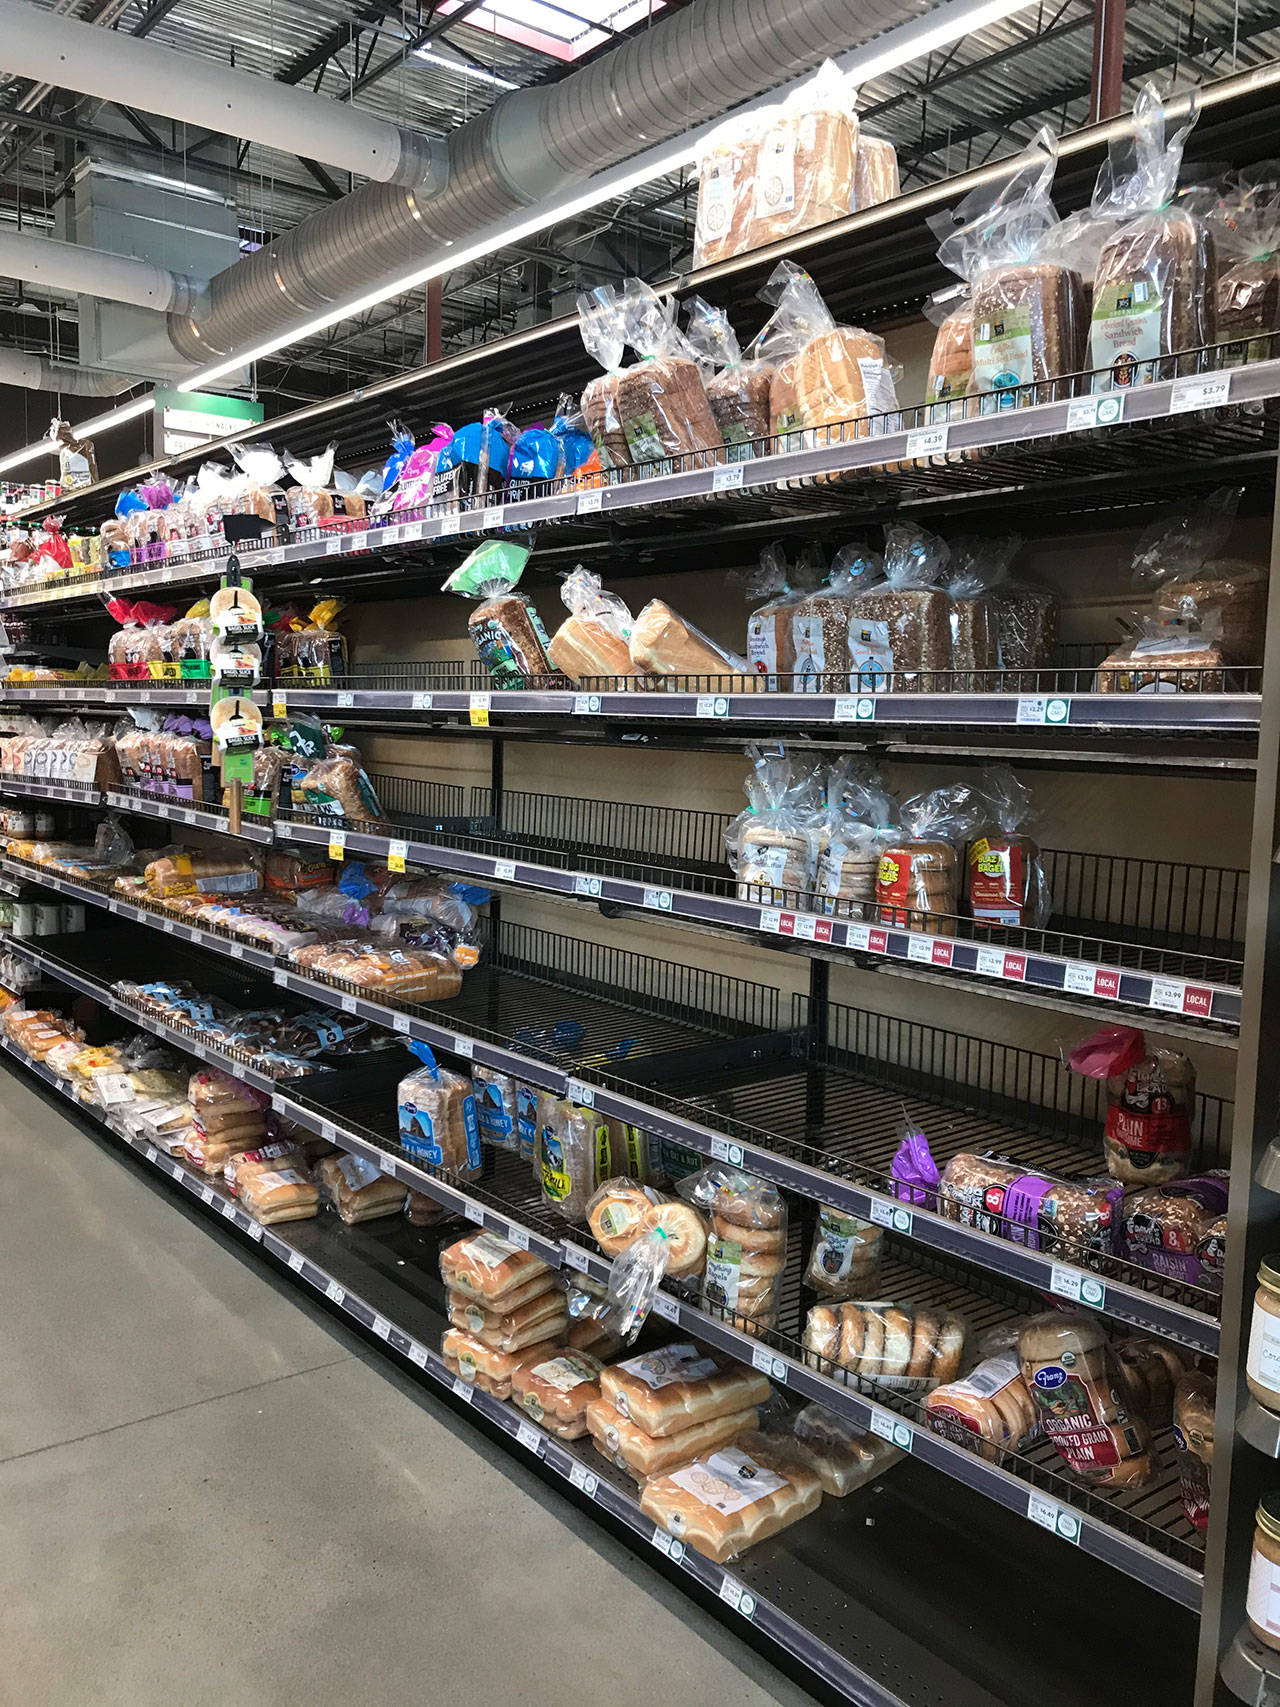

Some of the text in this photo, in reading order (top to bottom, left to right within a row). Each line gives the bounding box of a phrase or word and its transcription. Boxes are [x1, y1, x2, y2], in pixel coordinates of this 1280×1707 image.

[1104, 327, 1143, 340] Sandwich
[1113, 337, 1136, 348] Bread
[1203, 384, 1226, 396] $3.79
[924, 435, 943, 444] $4.39
[433, 480, 448, 496] FREE
[977, 864, 1004, 873] BAGEL
[780, 919, 793, 928] LOCAL
[816, 926, 829, 935] LOCAL
[870, 936, 885, 946] LOCAL
[934, 947, 950, 958] LOCAL
[1005, 960, 1023, 971] LOCAL
[1077, 973, 1093, 982] $3.99
[1096, 977, 1116, 989] LOCAL
[1164, 990, 1182, 999] $3.99
[1186, 994, 1207, 1007] LOCAL
[1118, 1112, 1144, 1137] PLAIN
[1037, 1370, 1064, 1387] Franz
[1046, 1413, 1092, 1431] ORGANIC
[1081, 1430, 1109, 1446] GRAIN
[1065, 1446, 1095, 1461] PLAIN
